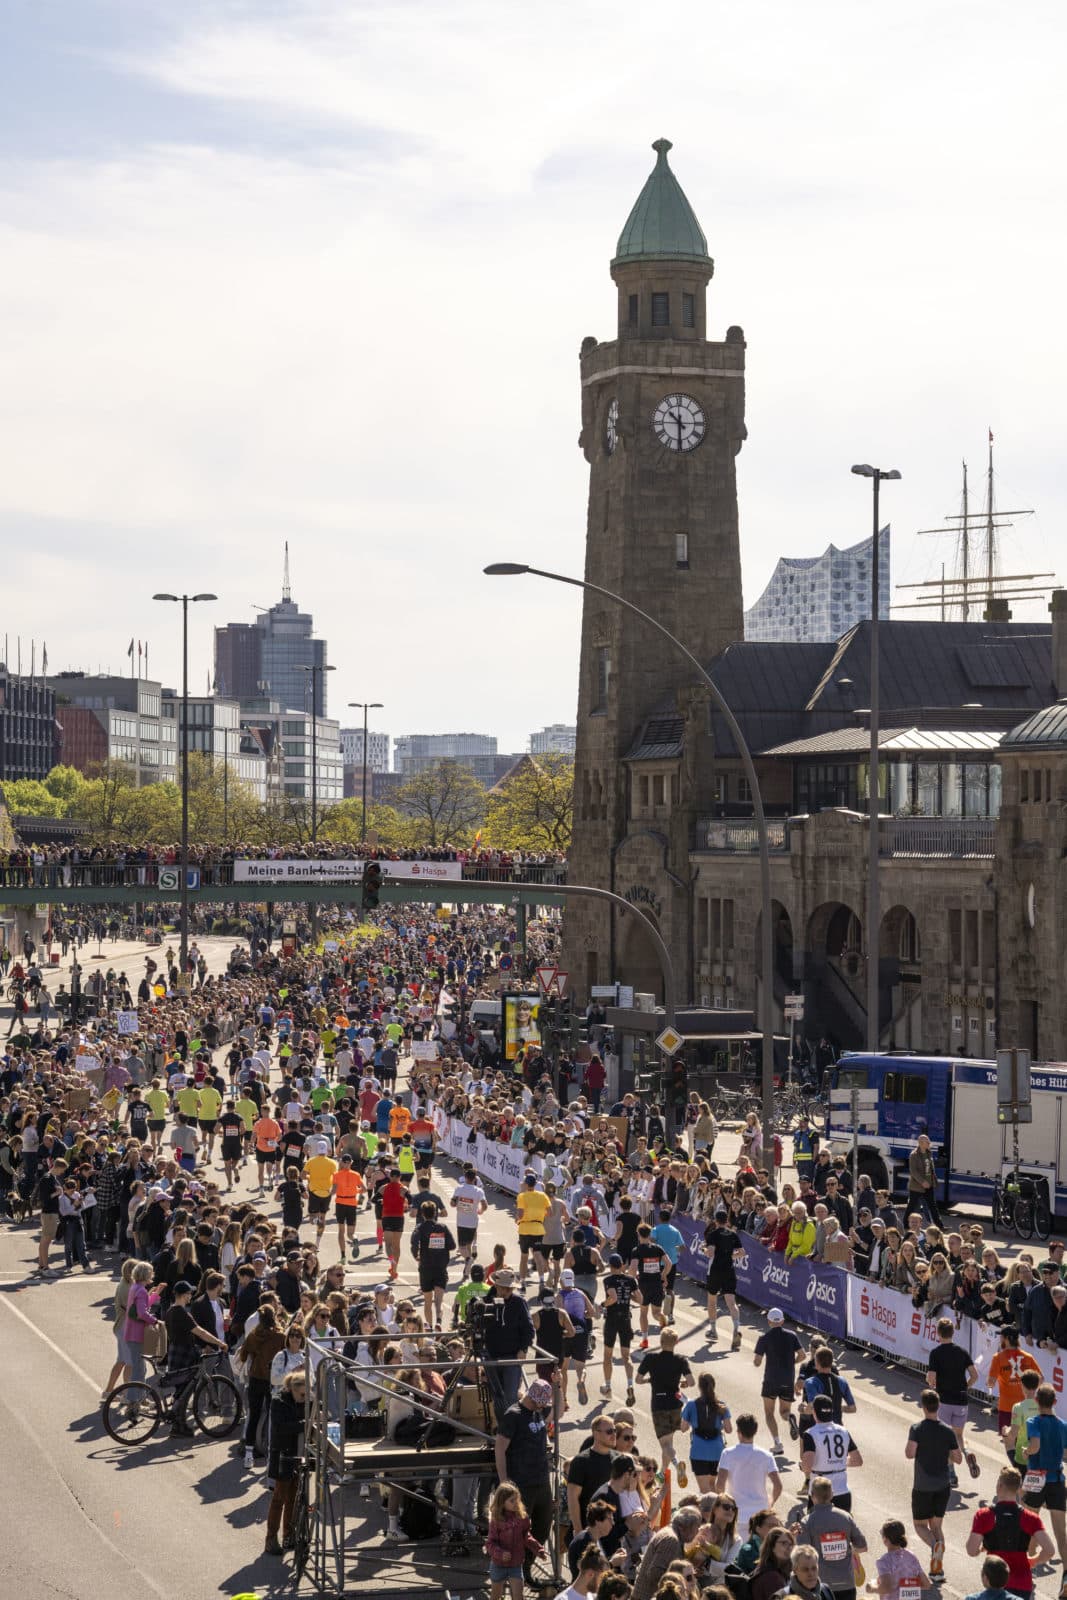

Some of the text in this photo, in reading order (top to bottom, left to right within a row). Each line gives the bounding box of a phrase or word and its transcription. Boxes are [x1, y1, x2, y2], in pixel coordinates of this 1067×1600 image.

[160, 872, 177, 888] S
[248, 865, 283, 876] Meine
[287, 865, 316, 876] Bank
[422, 866, 448, 876] Haspa
[816, 1282, 836, 1305] asics
[871, 1298, 896, 1330] Haspa
[823, 1434, 845, 1459] 18
